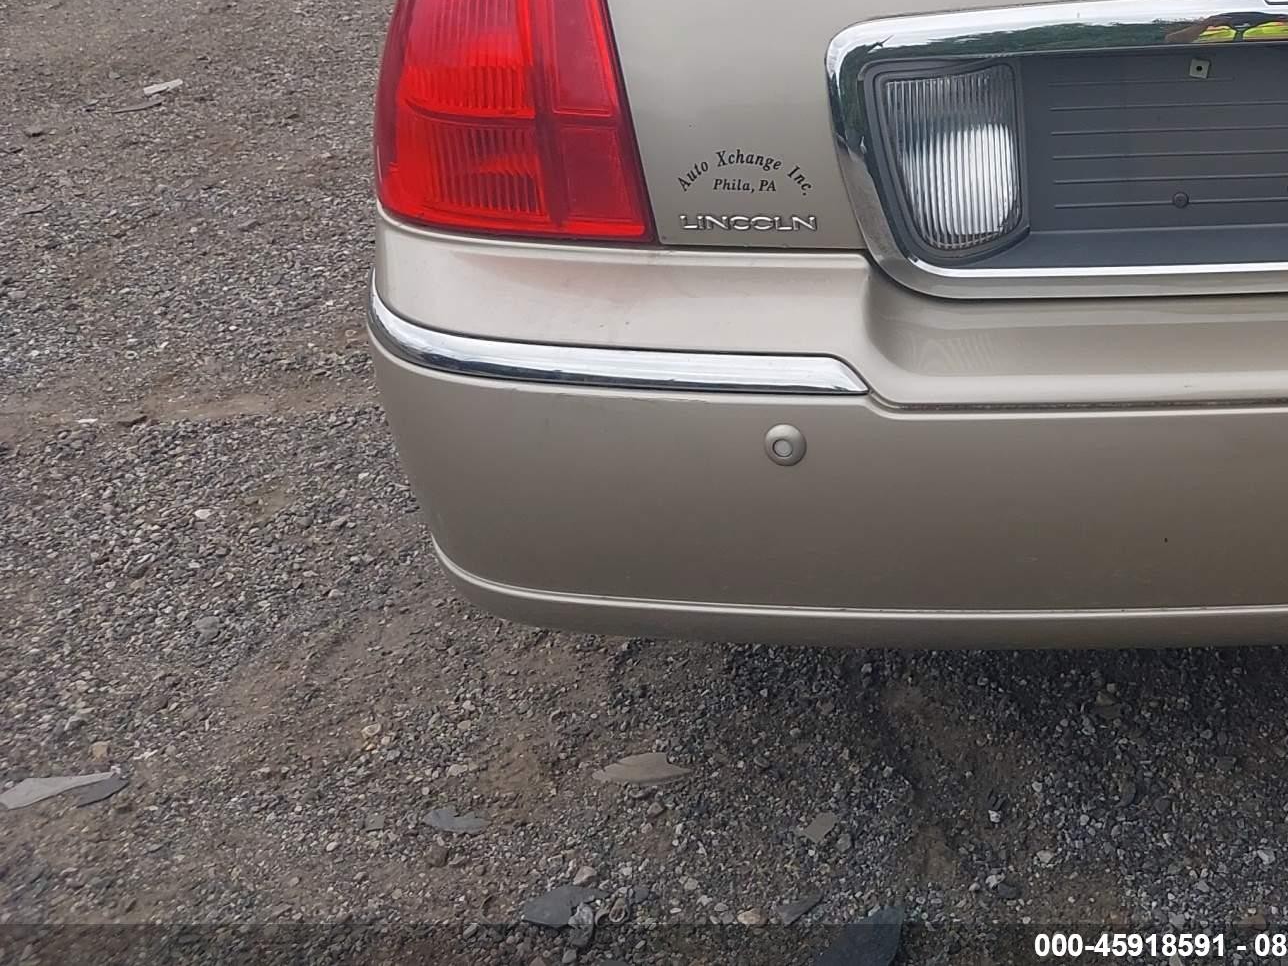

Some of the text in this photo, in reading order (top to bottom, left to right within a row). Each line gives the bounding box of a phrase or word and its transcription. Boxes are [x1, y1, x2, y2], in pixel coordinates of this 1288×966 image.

[677, 148, 813, 196] Auto Xchange Inc.
[713, 178, 777, 194] Phila, PA
[679, 214, 817, 231] LINCOLN
